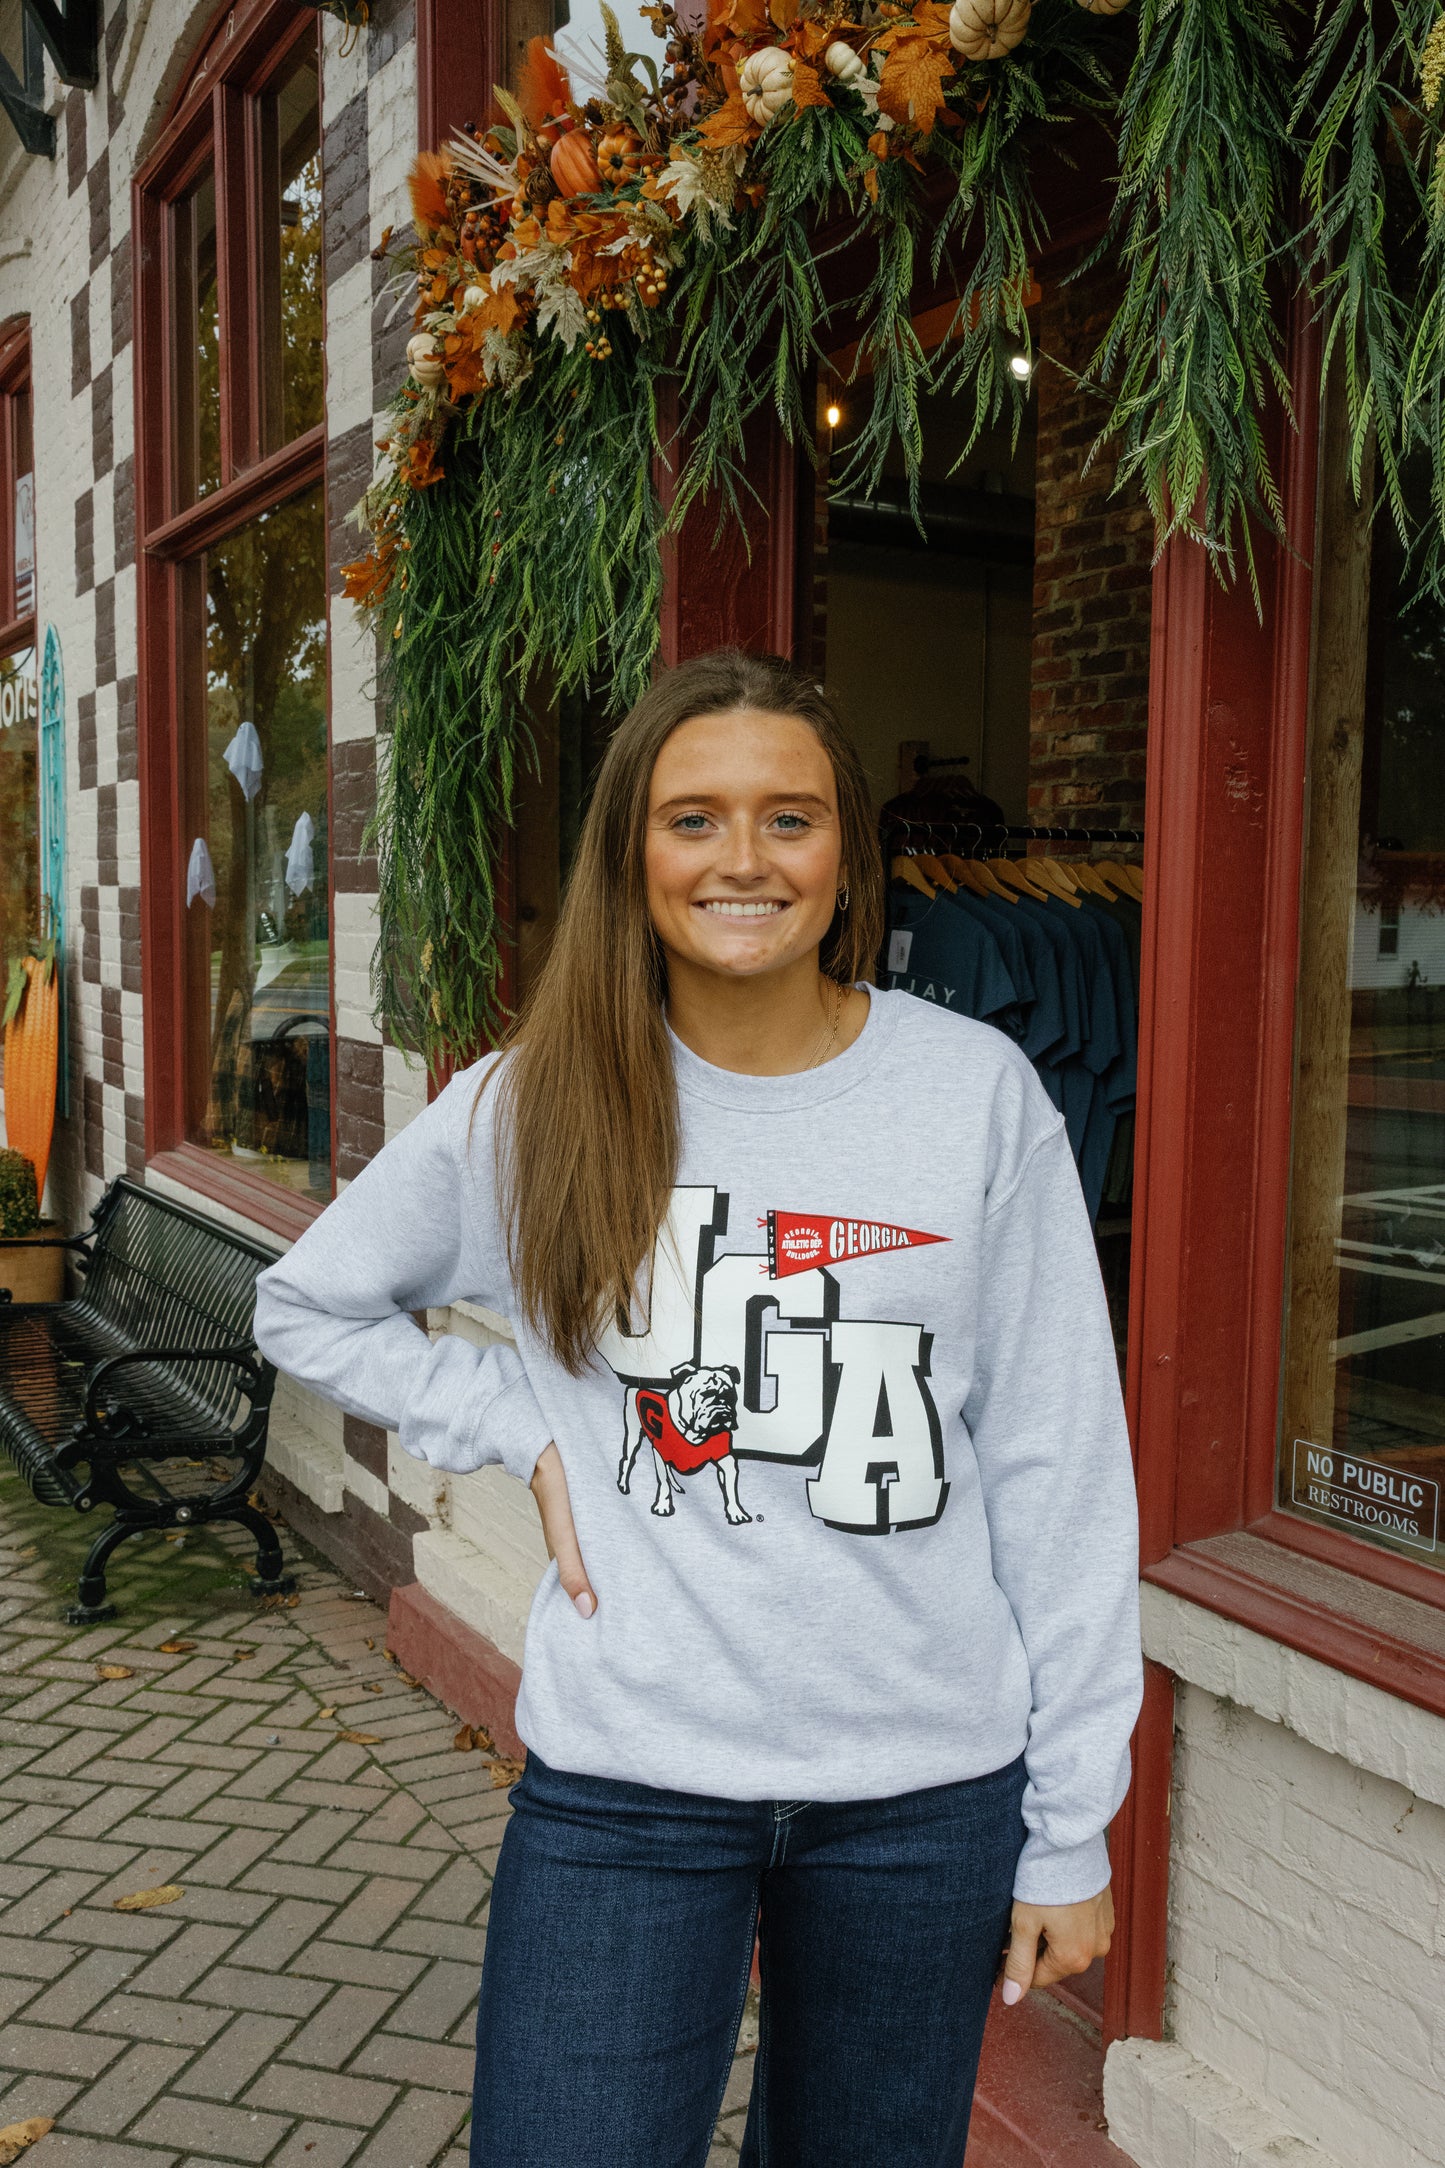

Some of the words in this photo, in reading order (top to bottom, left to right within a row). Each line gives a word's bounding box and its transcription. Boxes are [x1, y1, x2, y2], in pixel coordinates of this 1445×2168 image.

[781, 1239, 810, 1250] ATHLETIC
[639, 1396, 663, 1440] G
[1307, 1450, 1334, 1478] NO
[1343, 1462, 1424, 1508] PUBLIC
[1308, 1484, 1419, 1537] RESTROOMS
